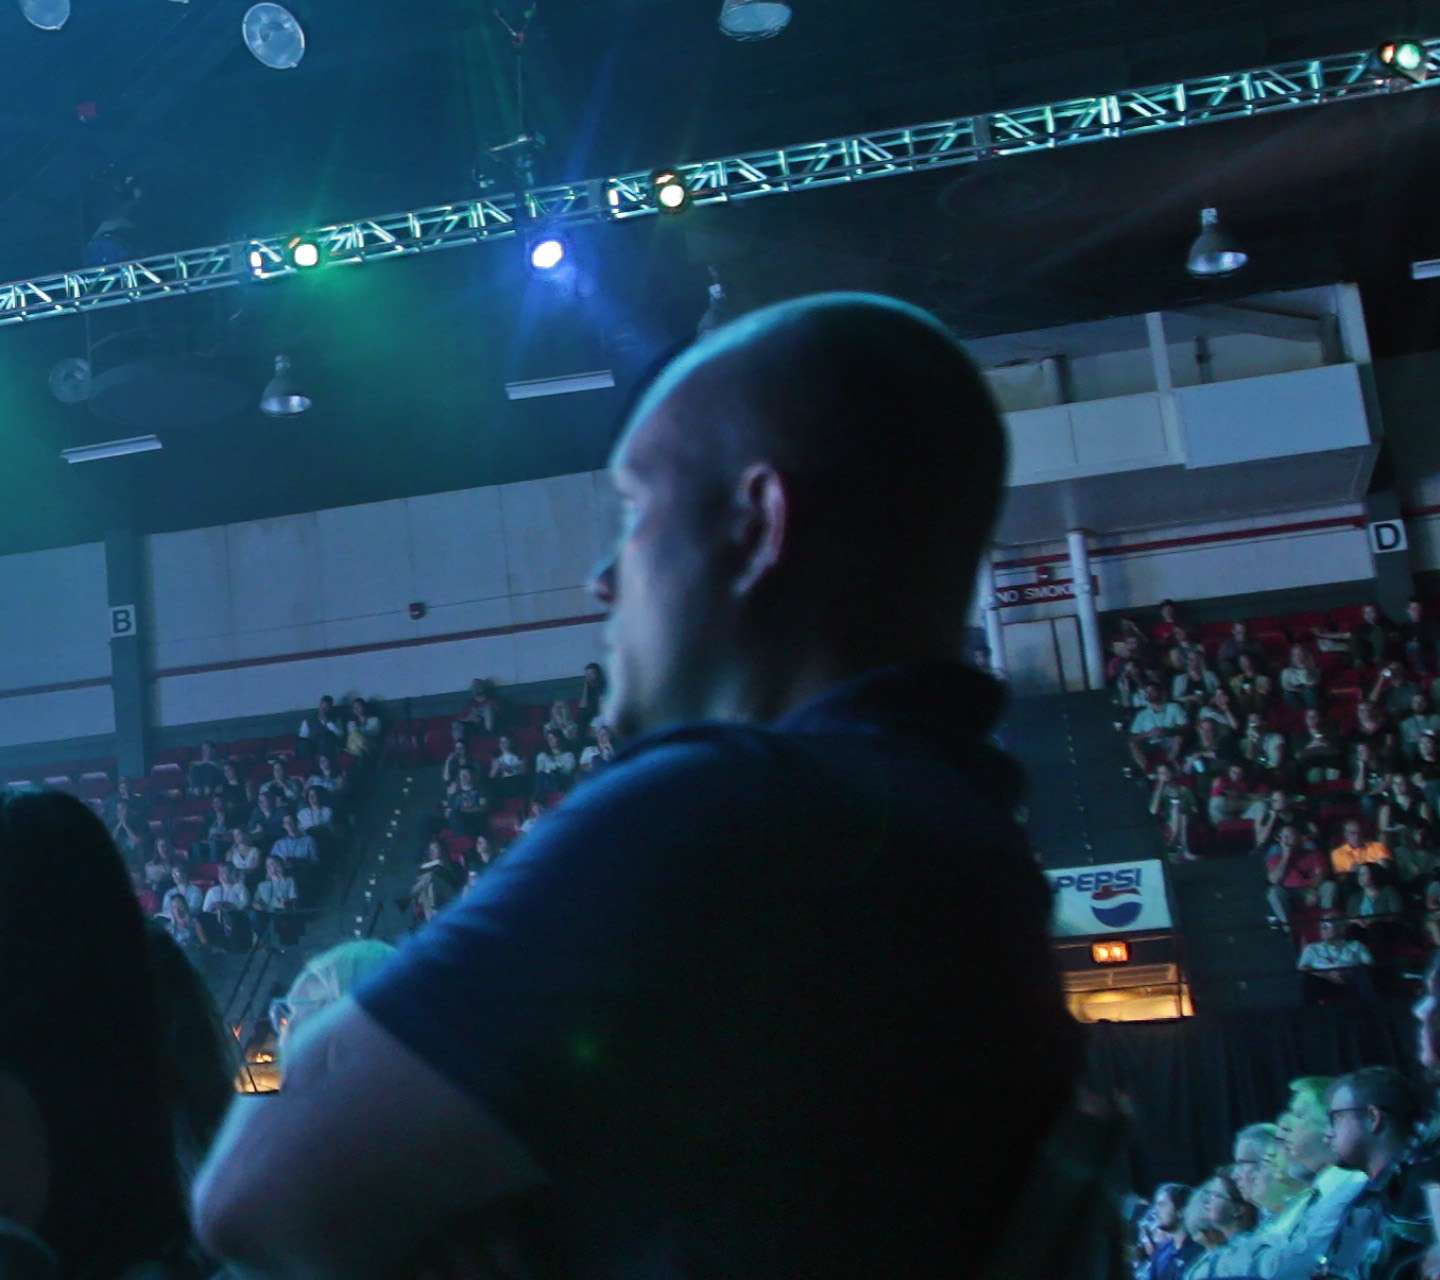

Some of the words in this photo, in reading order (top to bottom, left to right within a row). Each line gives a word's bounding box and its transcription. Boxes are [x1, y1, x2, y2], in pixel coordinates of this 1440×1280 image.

[1375, 523, 1401, 550] D
[112, 609, 132, 633] B
[1055, 868, 1143, 892] PEPSI
